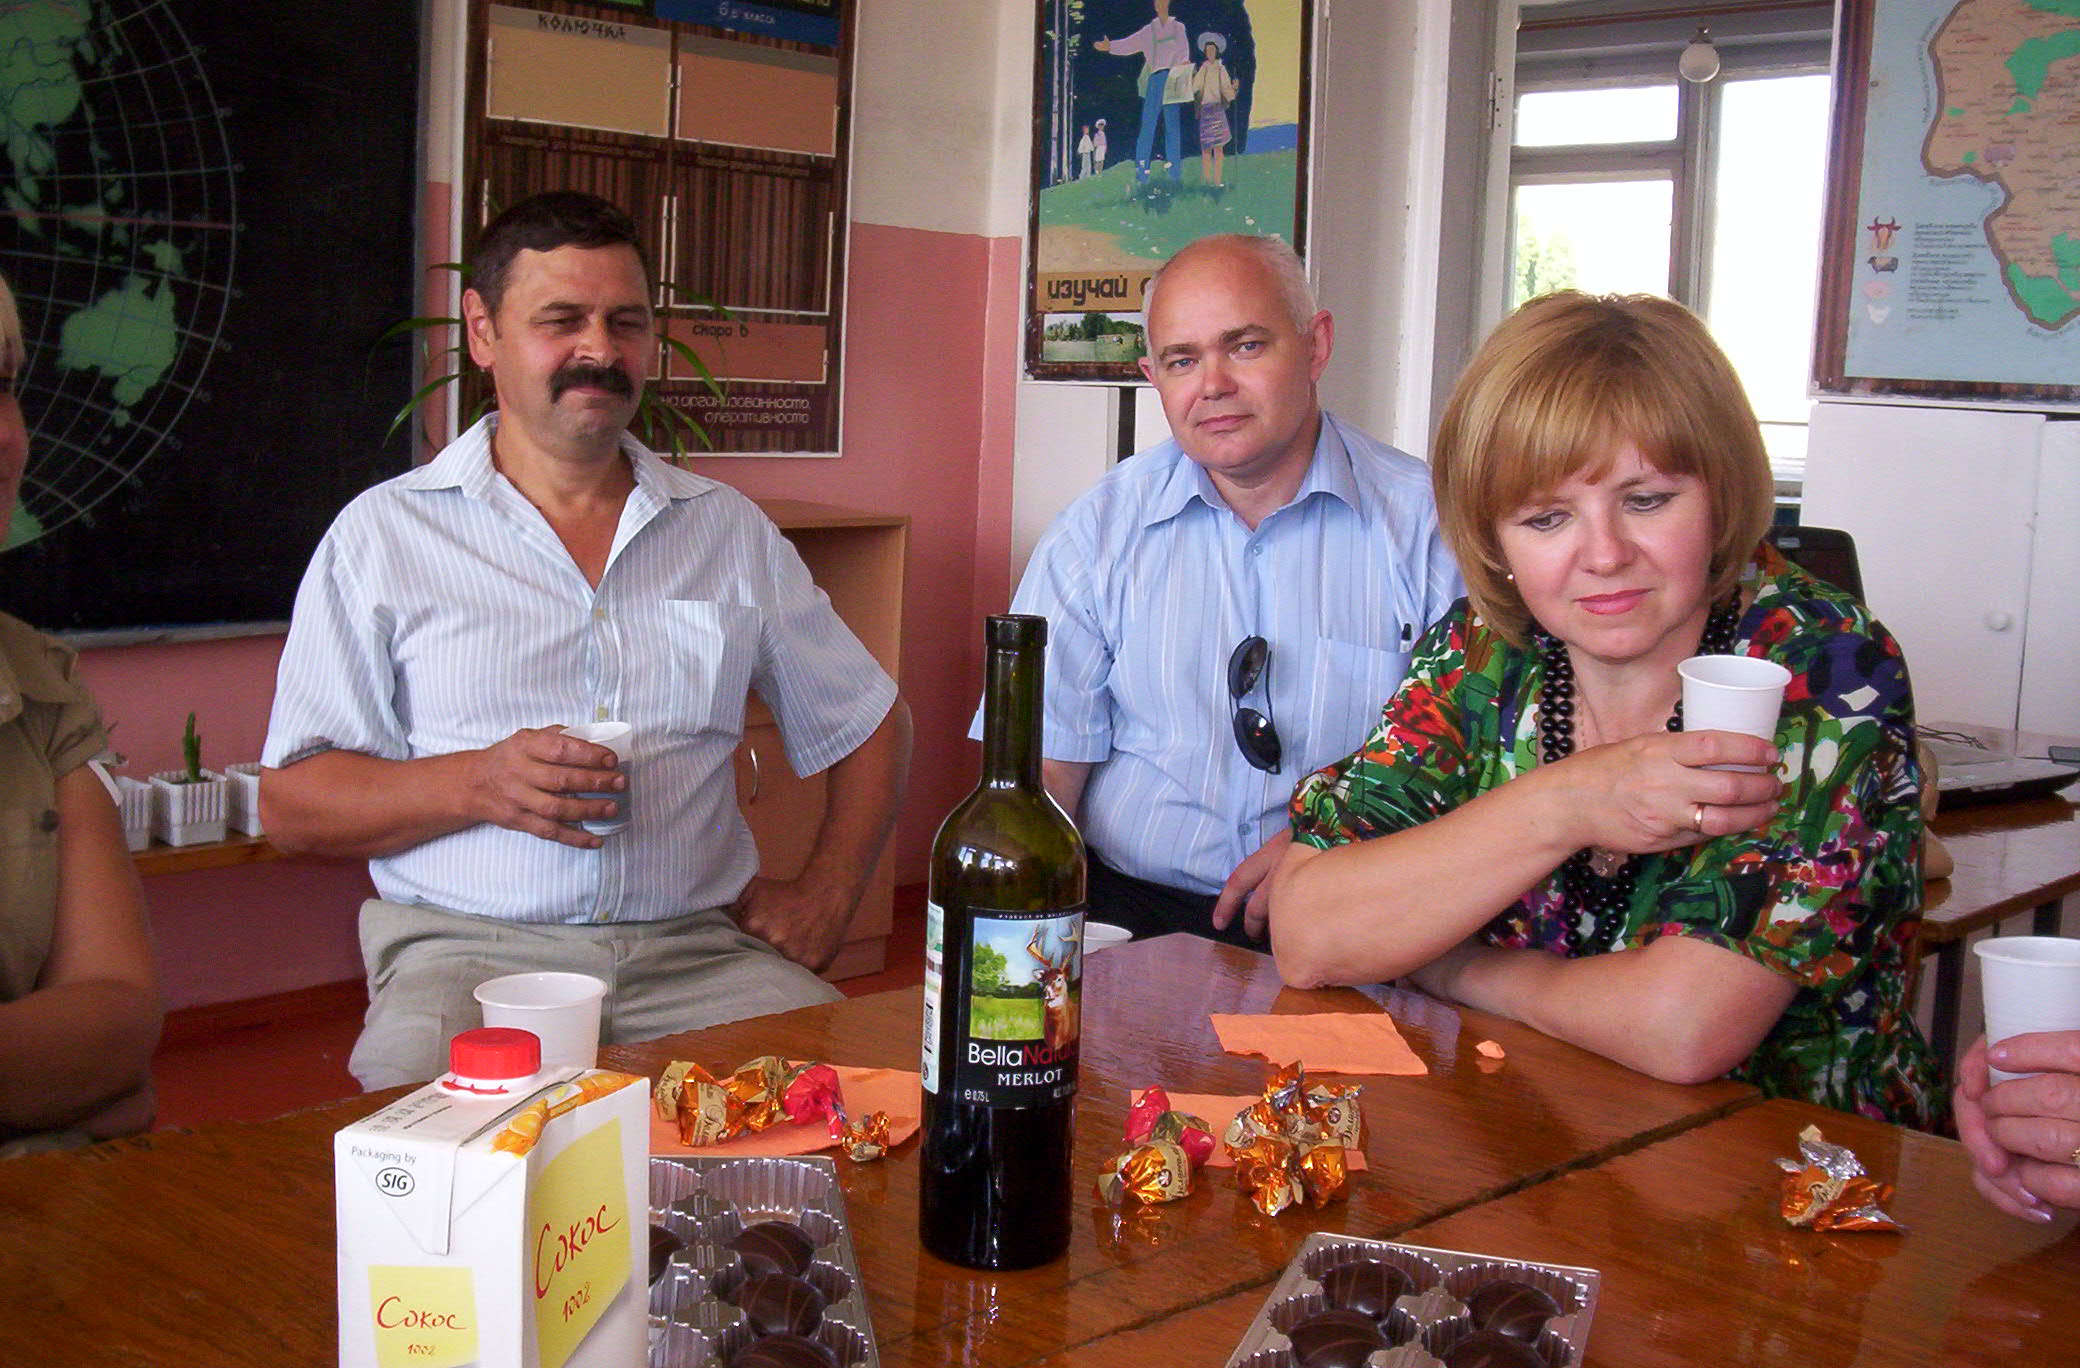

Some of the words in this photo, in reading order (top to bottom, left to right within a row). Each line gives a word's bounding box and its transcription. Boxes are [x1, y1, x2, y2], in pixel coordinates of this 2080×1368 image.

[537, 13, 627, 41] КОЛЮЧКА
[1046, 274, 1128, 306] изучай
[997, 1068, 1063, 1087] MERLOT
[351, 1145, 401, 1165] Packaging
[404, 1152, 417, 1165] by
[381, 1173, 408, 1190] SIG
